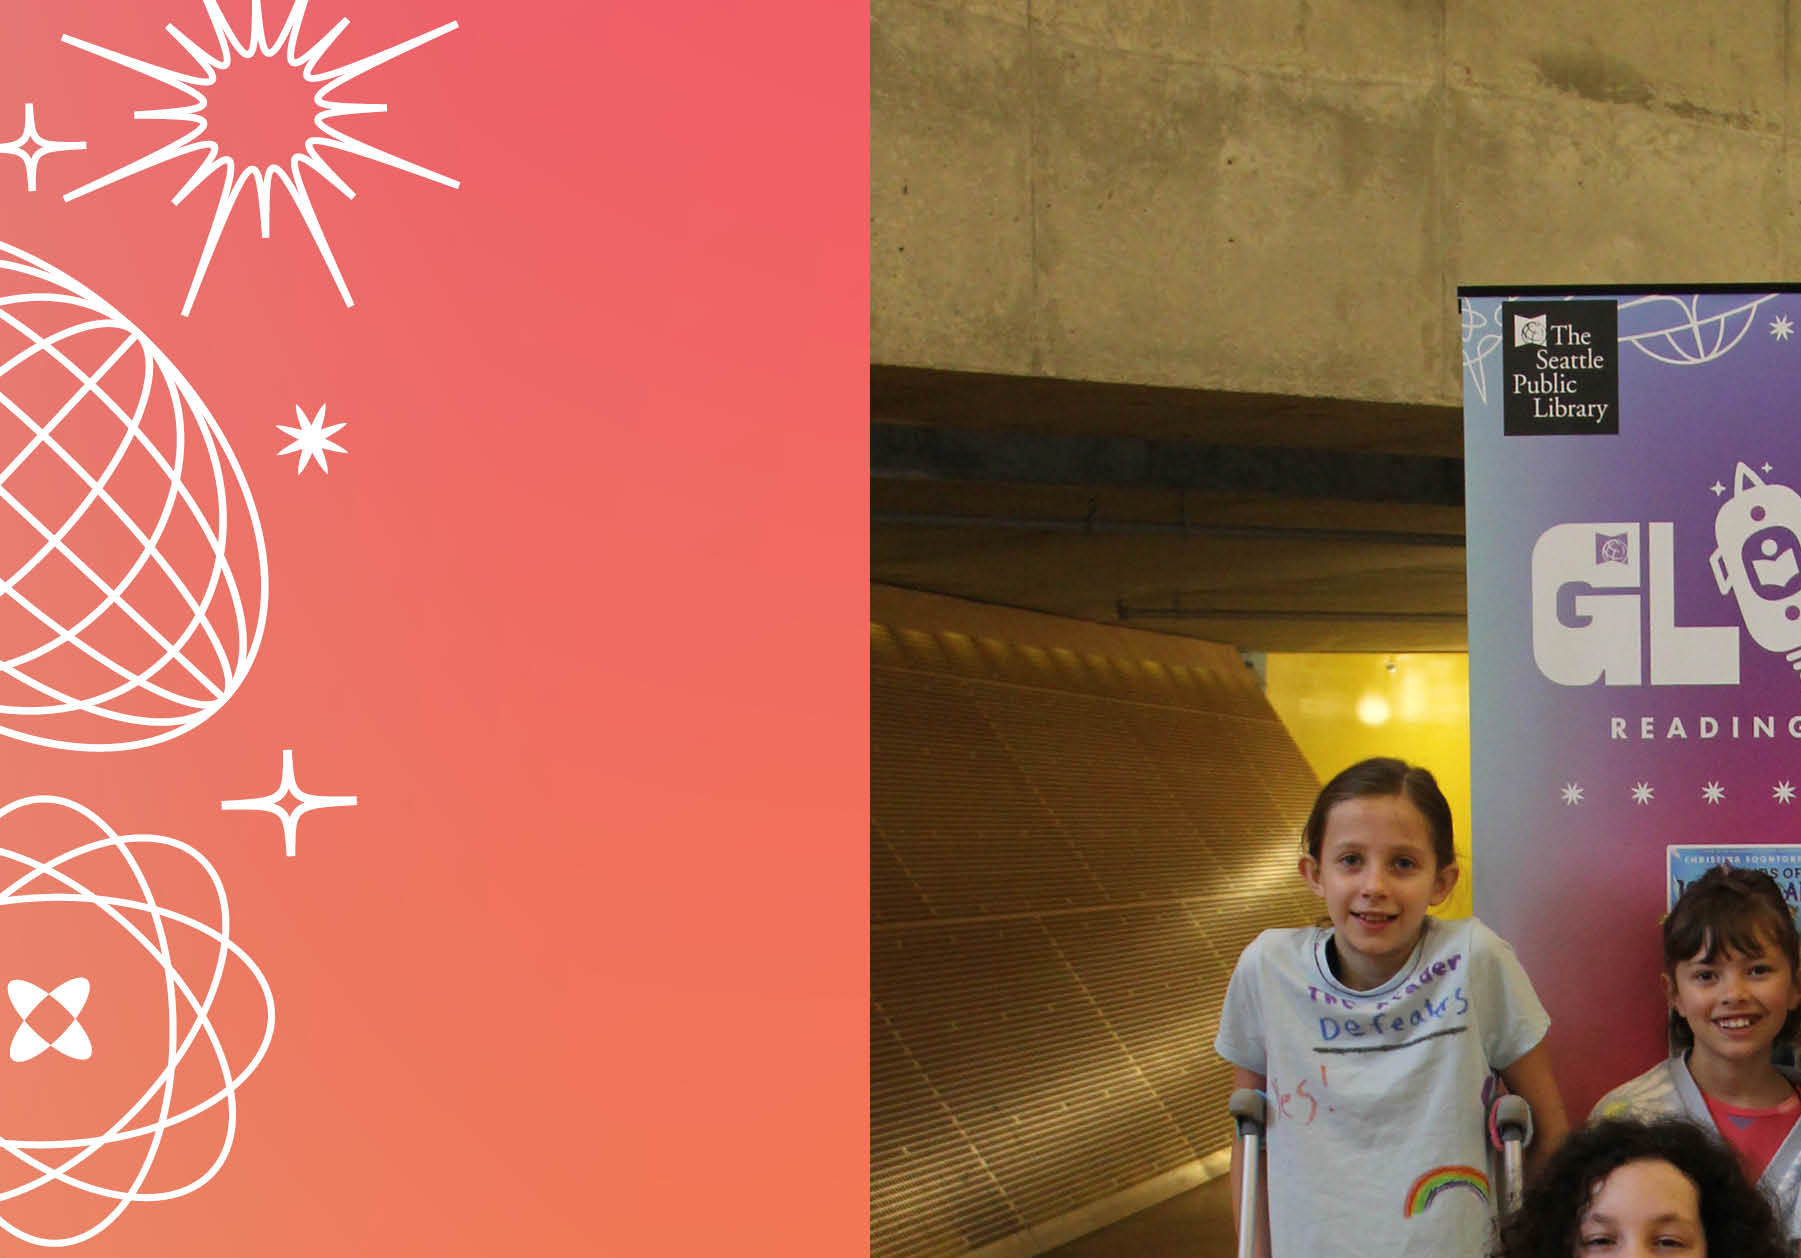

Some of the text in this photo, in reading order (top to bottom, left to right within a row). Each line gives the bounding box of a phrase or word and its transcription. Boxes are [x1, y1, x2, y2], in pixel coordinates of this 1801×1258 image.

[1550, 324, 1591, 345] The
[1536, 347, 1604, 369] Seattle
[1512, 372, 1577, 394] Public
[1533, 396, 1608, 424] Library
